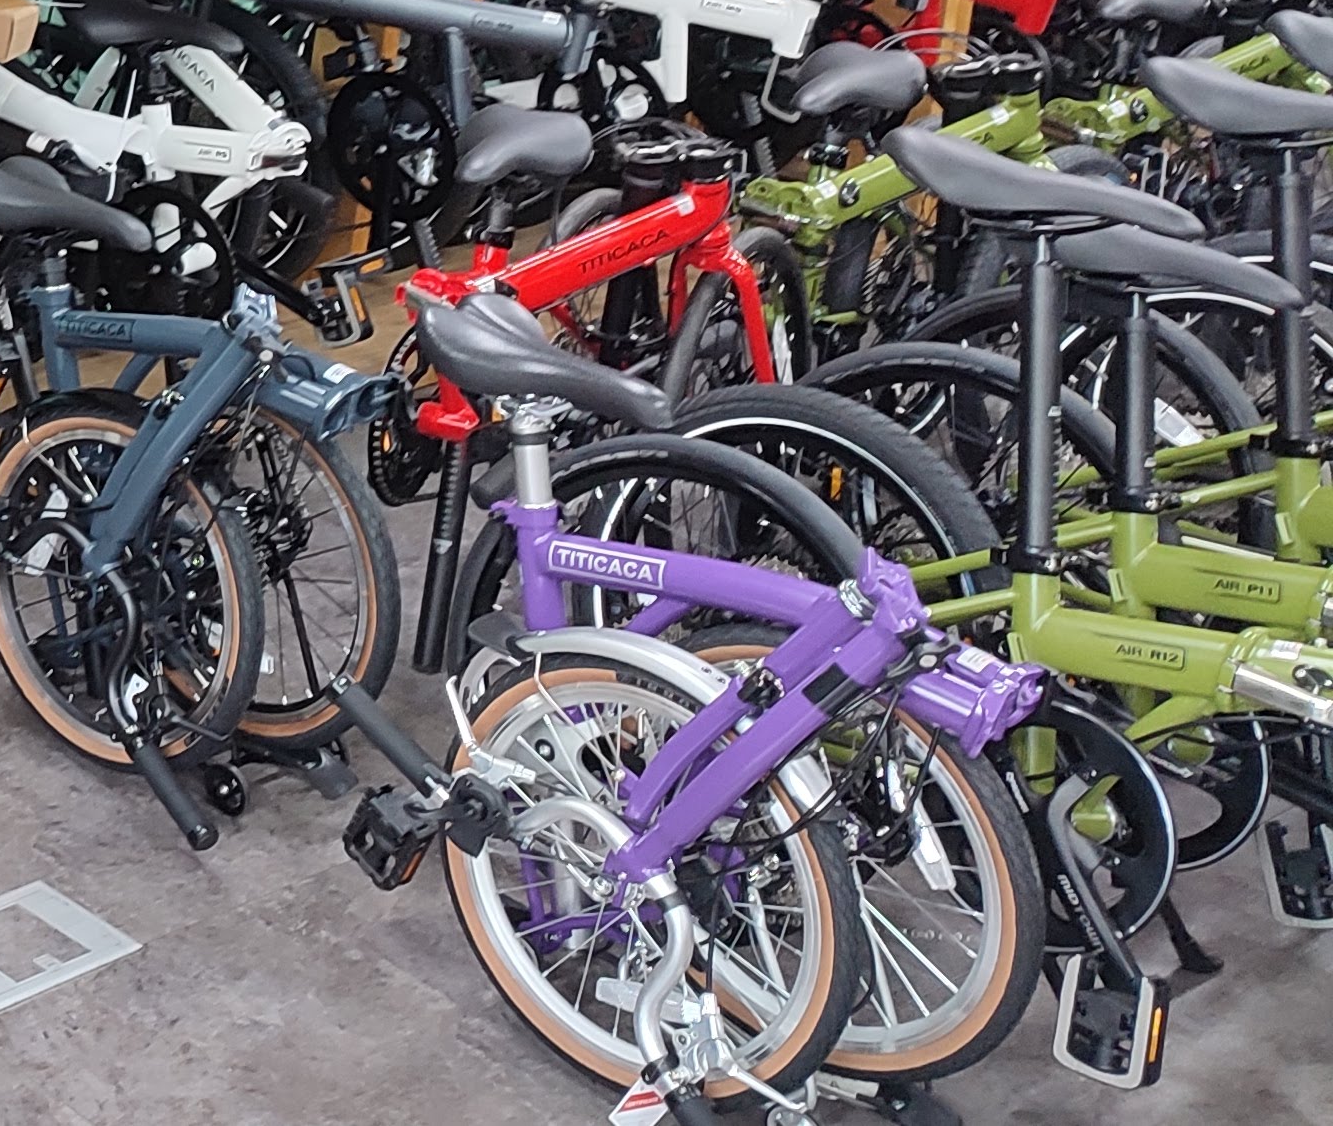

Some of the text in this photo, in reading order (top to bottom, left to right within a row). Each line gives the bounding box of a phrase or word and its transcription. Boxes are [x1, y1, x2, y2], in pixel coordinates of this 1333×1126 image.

[577, 229, 670, 274] TITICACA
[557, 548, 653, 582] TITICACA
[1213, 578, 1240, 592] AIR
[1115, 643, 1179, 663] AIR R12
